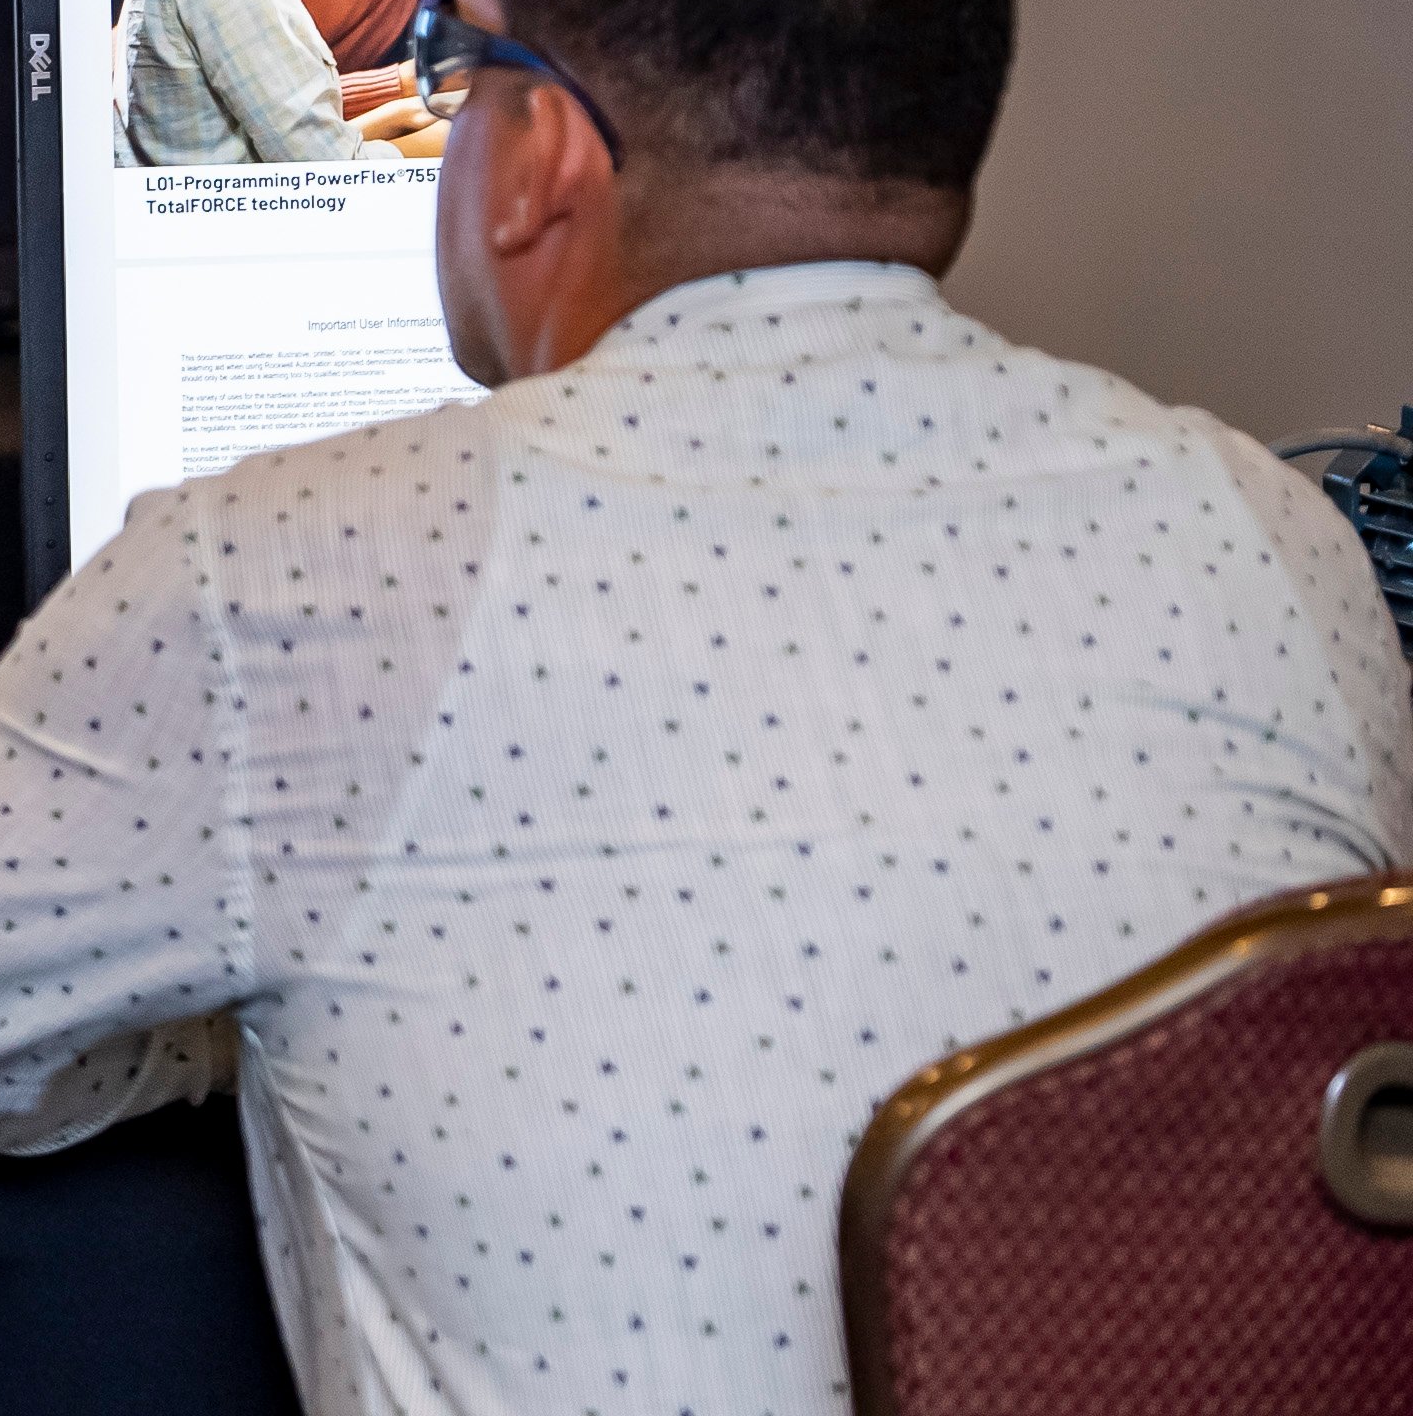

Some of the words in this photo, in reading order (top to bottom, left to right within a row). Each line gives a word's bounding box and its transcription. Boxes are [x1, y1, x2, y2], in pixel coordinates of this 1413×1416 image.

[29, 33, 52, 102] DELL
[146, 171, 300, 193] L01-Programming
[146, 197, 247, 214] TotalFORCE
[252, 195, 347, 212] technology
[308, 319, 357, 332] Important
[359, 318, 384, 329] User
[387, 316, 446, 328] Information
